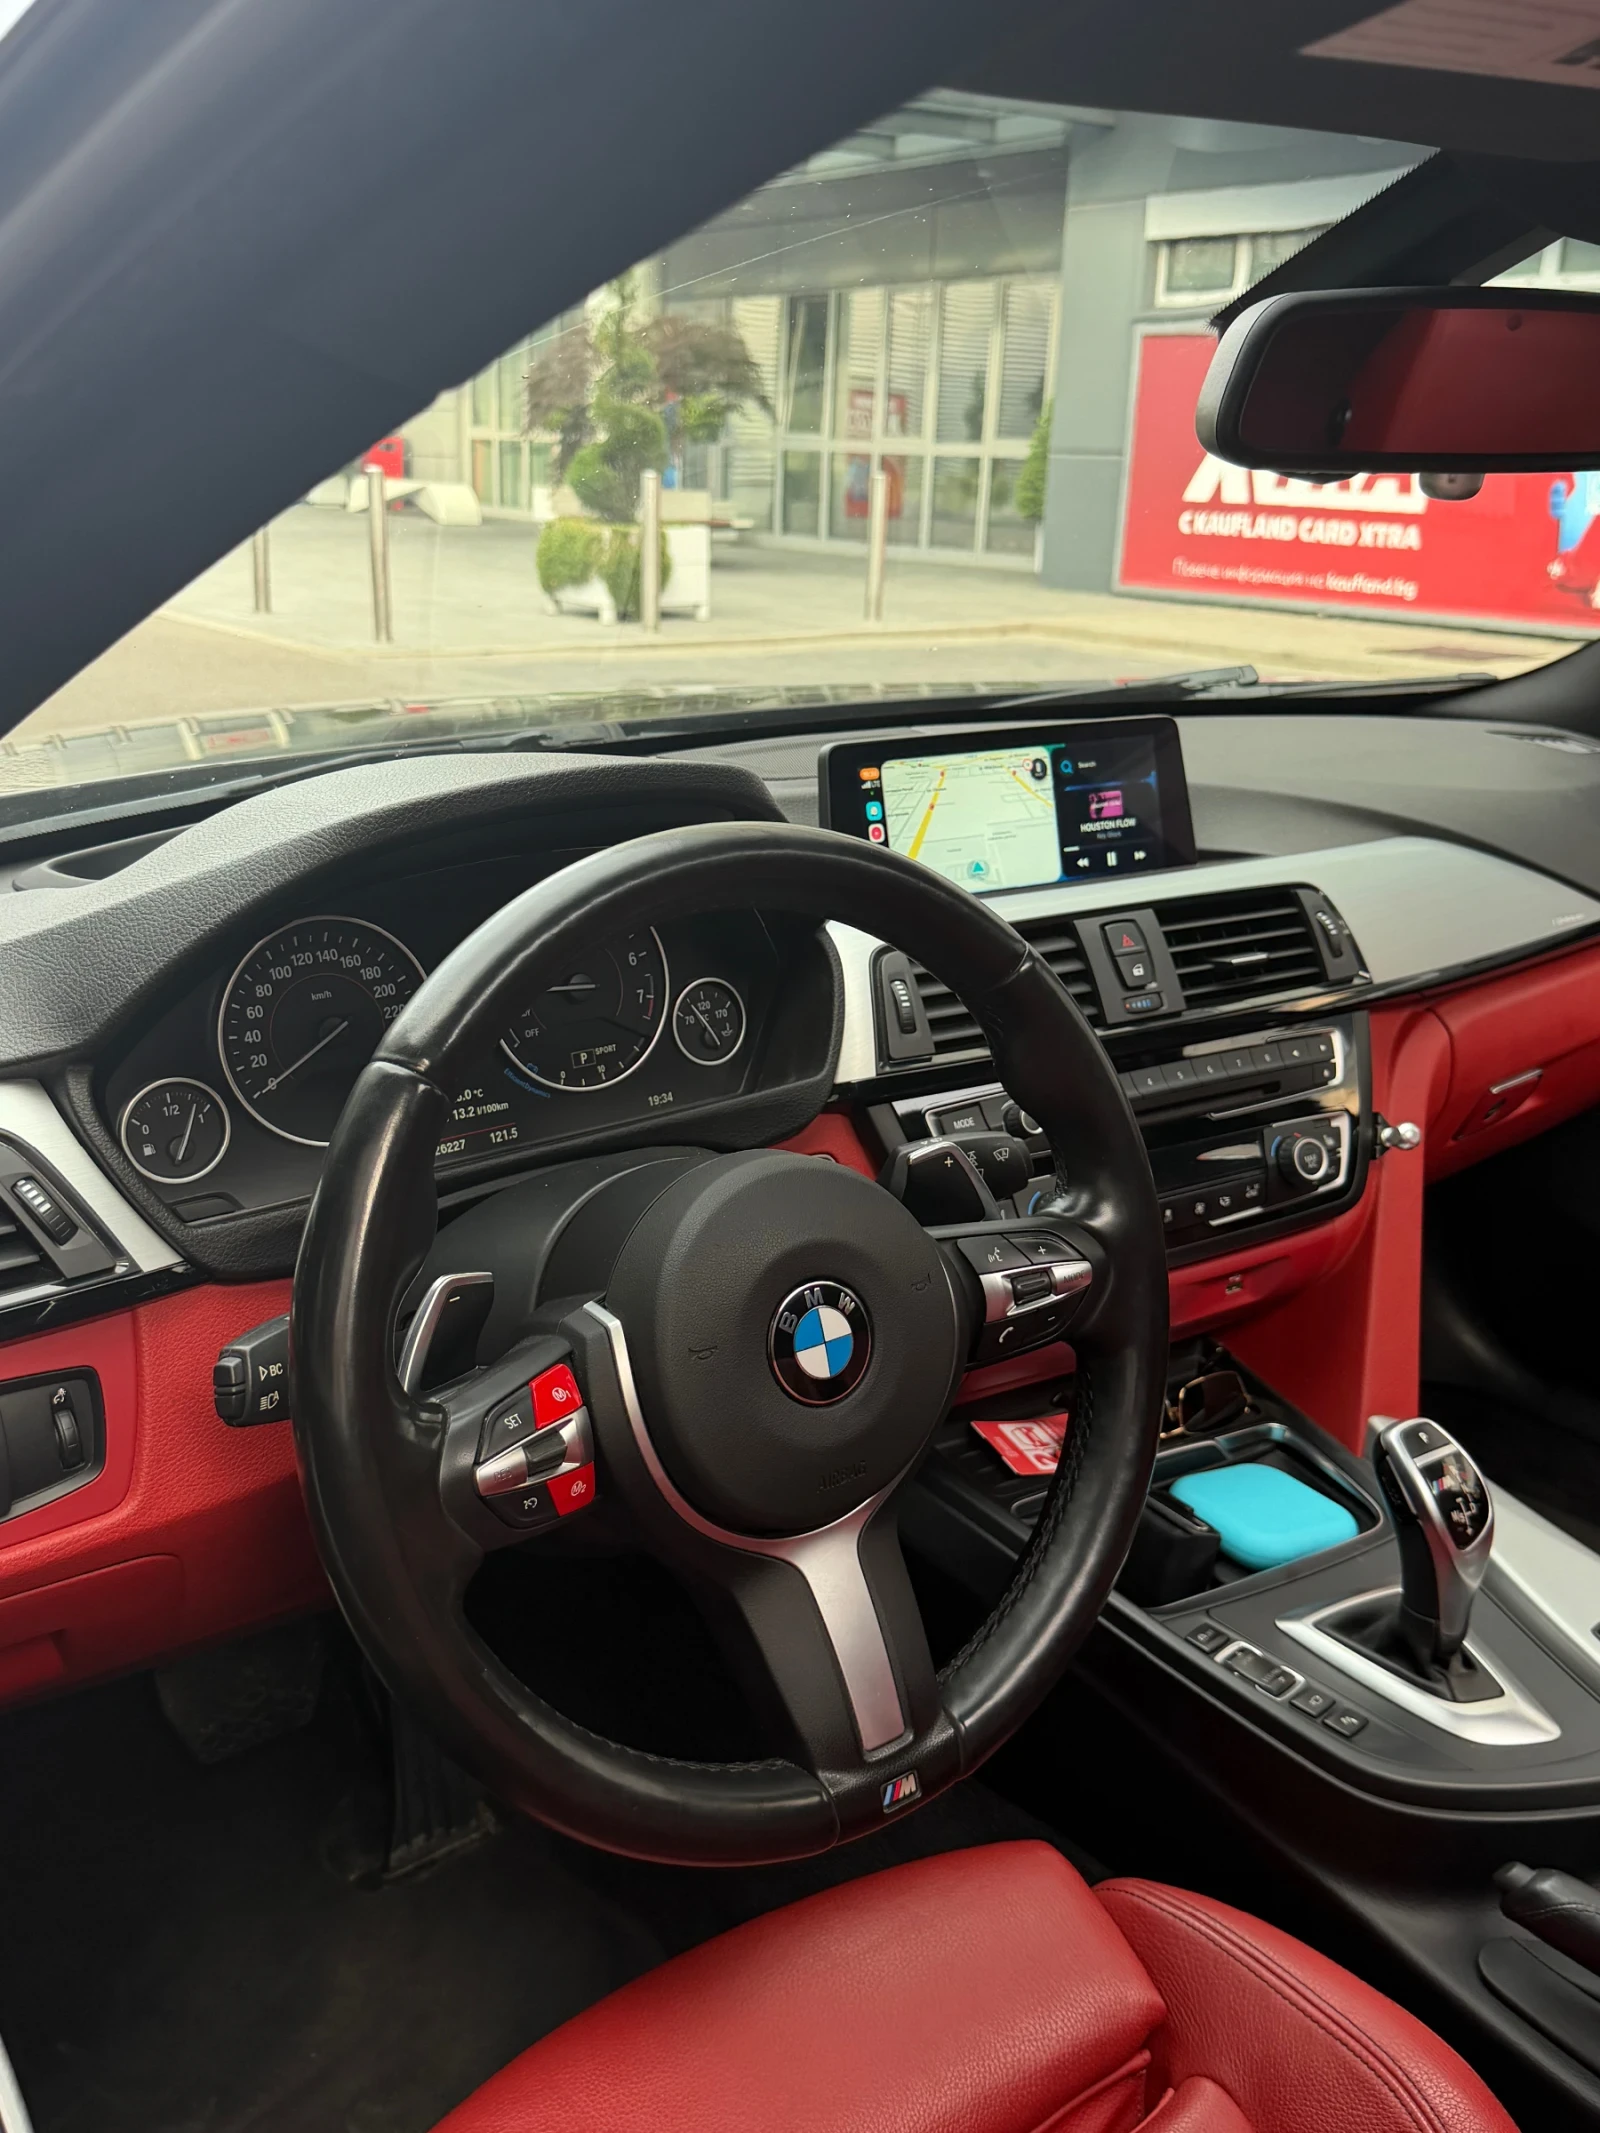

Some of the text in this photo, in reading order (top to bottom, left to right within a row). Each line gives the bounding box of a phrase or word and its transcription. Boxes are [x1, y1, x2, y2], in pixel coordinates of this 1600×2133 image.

[1192, 510, 1298, 541] KAUFLAND
[1298, 516, 1358, 547] CARD
[1357, 521, 1422, 550] XTRA
[1080, 817, 1137, 833] HOUSTON FLOW
[290, 952, 314, 967] 120
[315, 949, 339, 963] 140
[340, 954, 362, 969] 160
[628, 952, 637, 966] 6
[269, 965, 292, 980] 100
[360, 966, 382, 980] 180
[255, 983, 273, 998] 80
[311, 990, 332, 1001] km/h
[373, 983, 396, 998] 200
[636, 989, 644, 1003] 7
[246, 1005, 264, 1020] 60
[698, 1000, 711, 1011] 120
[684, 1015, 695, 1025] 70
[715, 1008, 728, 1019] 170
[244, 1029, 262, 1044] 40
[525, 1028, 540, 1038] OFF
[595, 1044, 616, 1055] SPORT
[250, 1053, 268, 1069] 20
[580, 1053, 587, 1064] P
[648, 1092, 674, 1106] 19:34
[163, 1104, 180, 1117] 1/2
[452, 1106, 475, 1120] 13.2
[142, 1124, 150, 1135] 0
[953, 1116, 976, 1130] MODE
[490, 1127, 518, 1143] 121.5
[779, 1287, 856, 1334] BMW
[269, 1362, 283, 1377] BC
[504, 1413, 522, 1430] SET
[493, 1466, 513, 1483] RES
